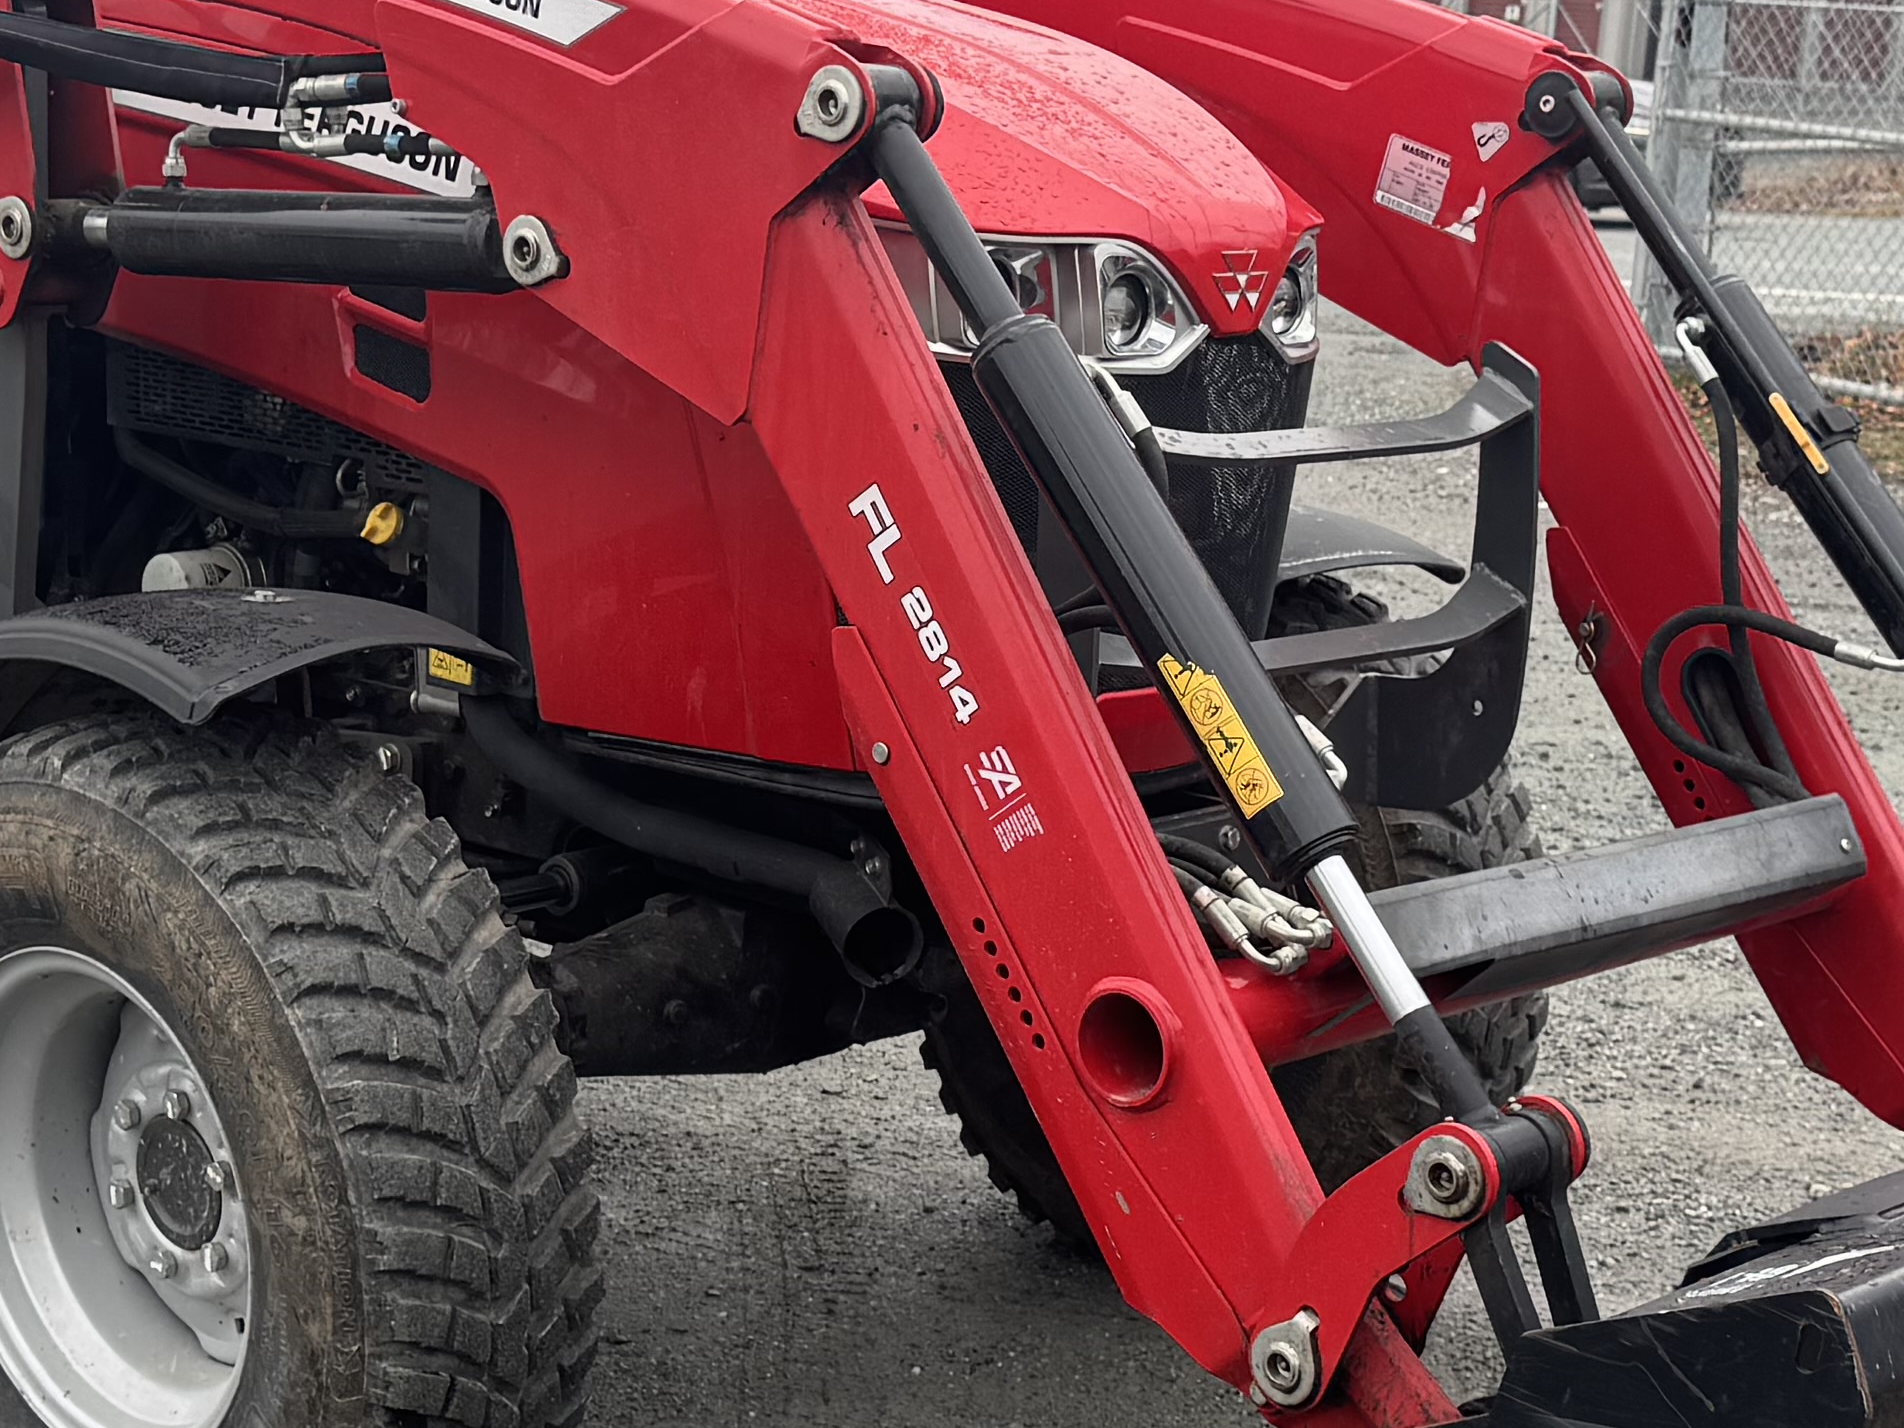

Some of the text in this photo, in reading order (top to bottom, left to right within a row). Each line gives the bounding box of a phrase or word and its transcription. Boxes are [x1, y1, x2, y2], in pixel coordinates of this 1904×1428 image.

[1402, 142, 1436, 162] MASSEY
[847, 483, 980, 725] FL 2814
